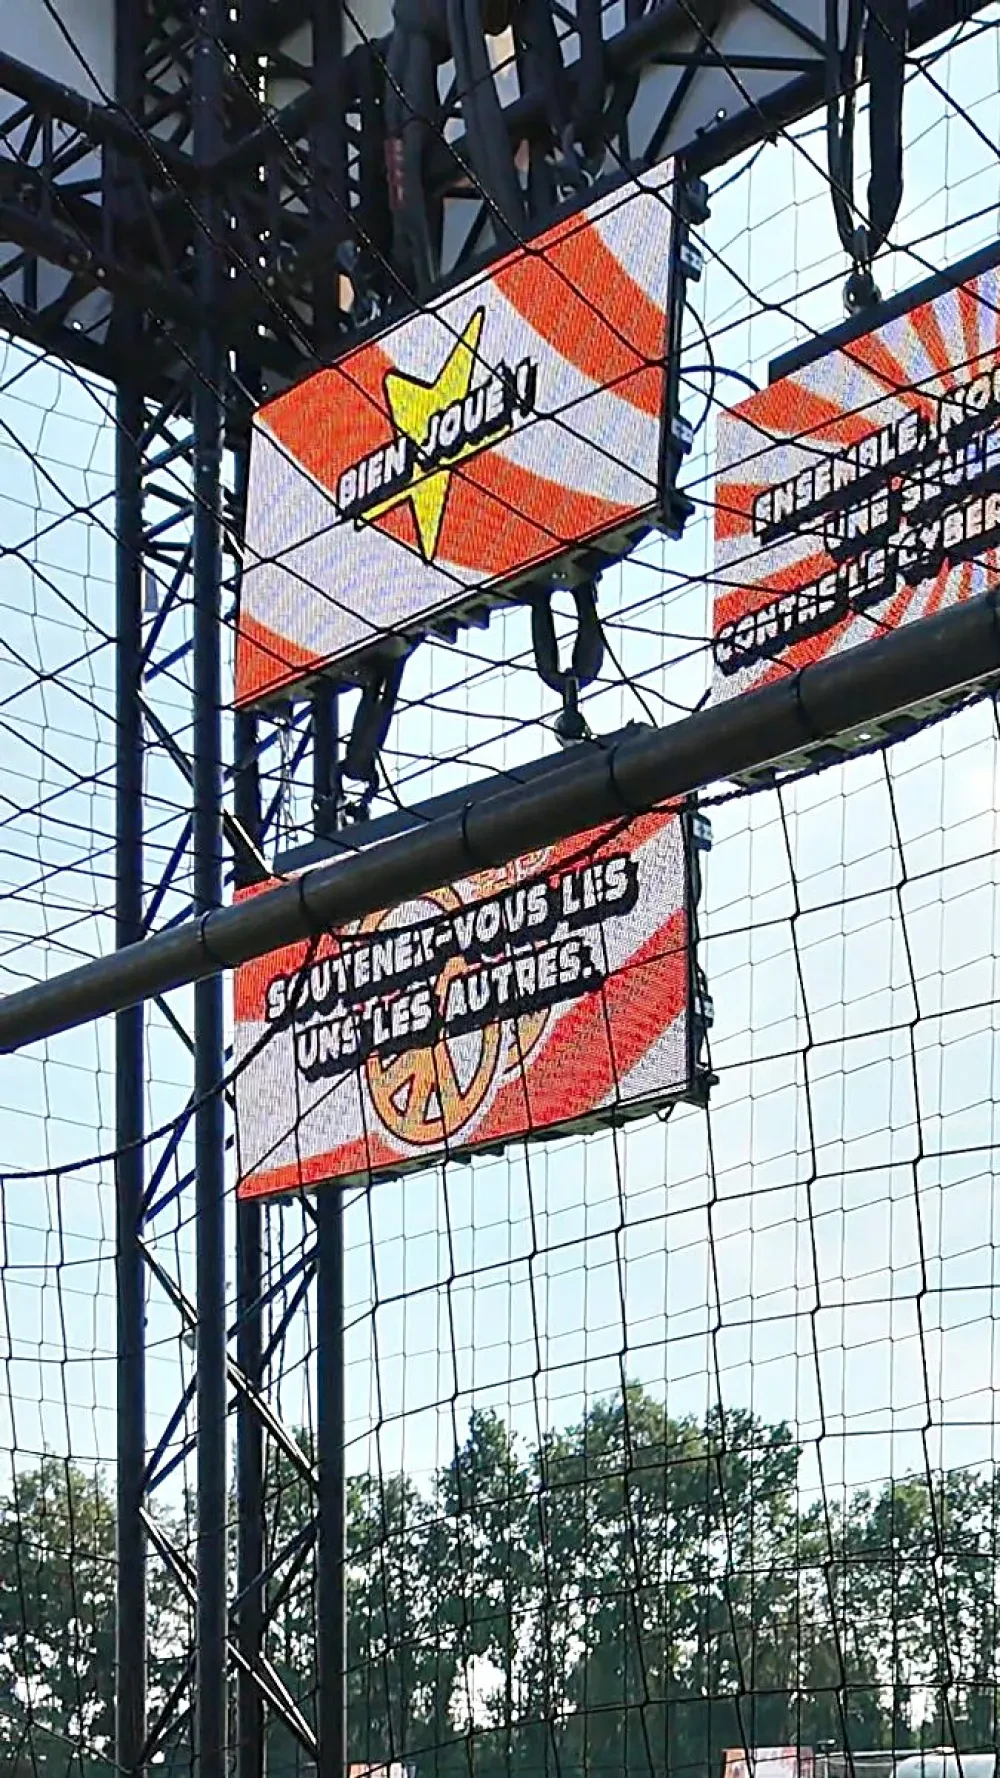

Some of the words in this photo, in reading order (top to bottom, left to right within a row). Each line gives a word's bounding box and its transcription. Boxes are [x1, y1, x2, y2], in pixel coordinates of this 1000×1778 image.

[338, 436, 407, 509] BIEN
[827, 487, 889, 550] UNE
[715, 571, 837, 663] CONTRE
[847, 551, 887, 599] LE
[267, 883, 549, 1020] SOUTENEZ-VOUS
[562, 857, 629, 915] LES
[298, 1017, 362, 1069] UNS
[372, 989, 432, 1046] LES
[446, 940, 593, 1022] AUTRES.
